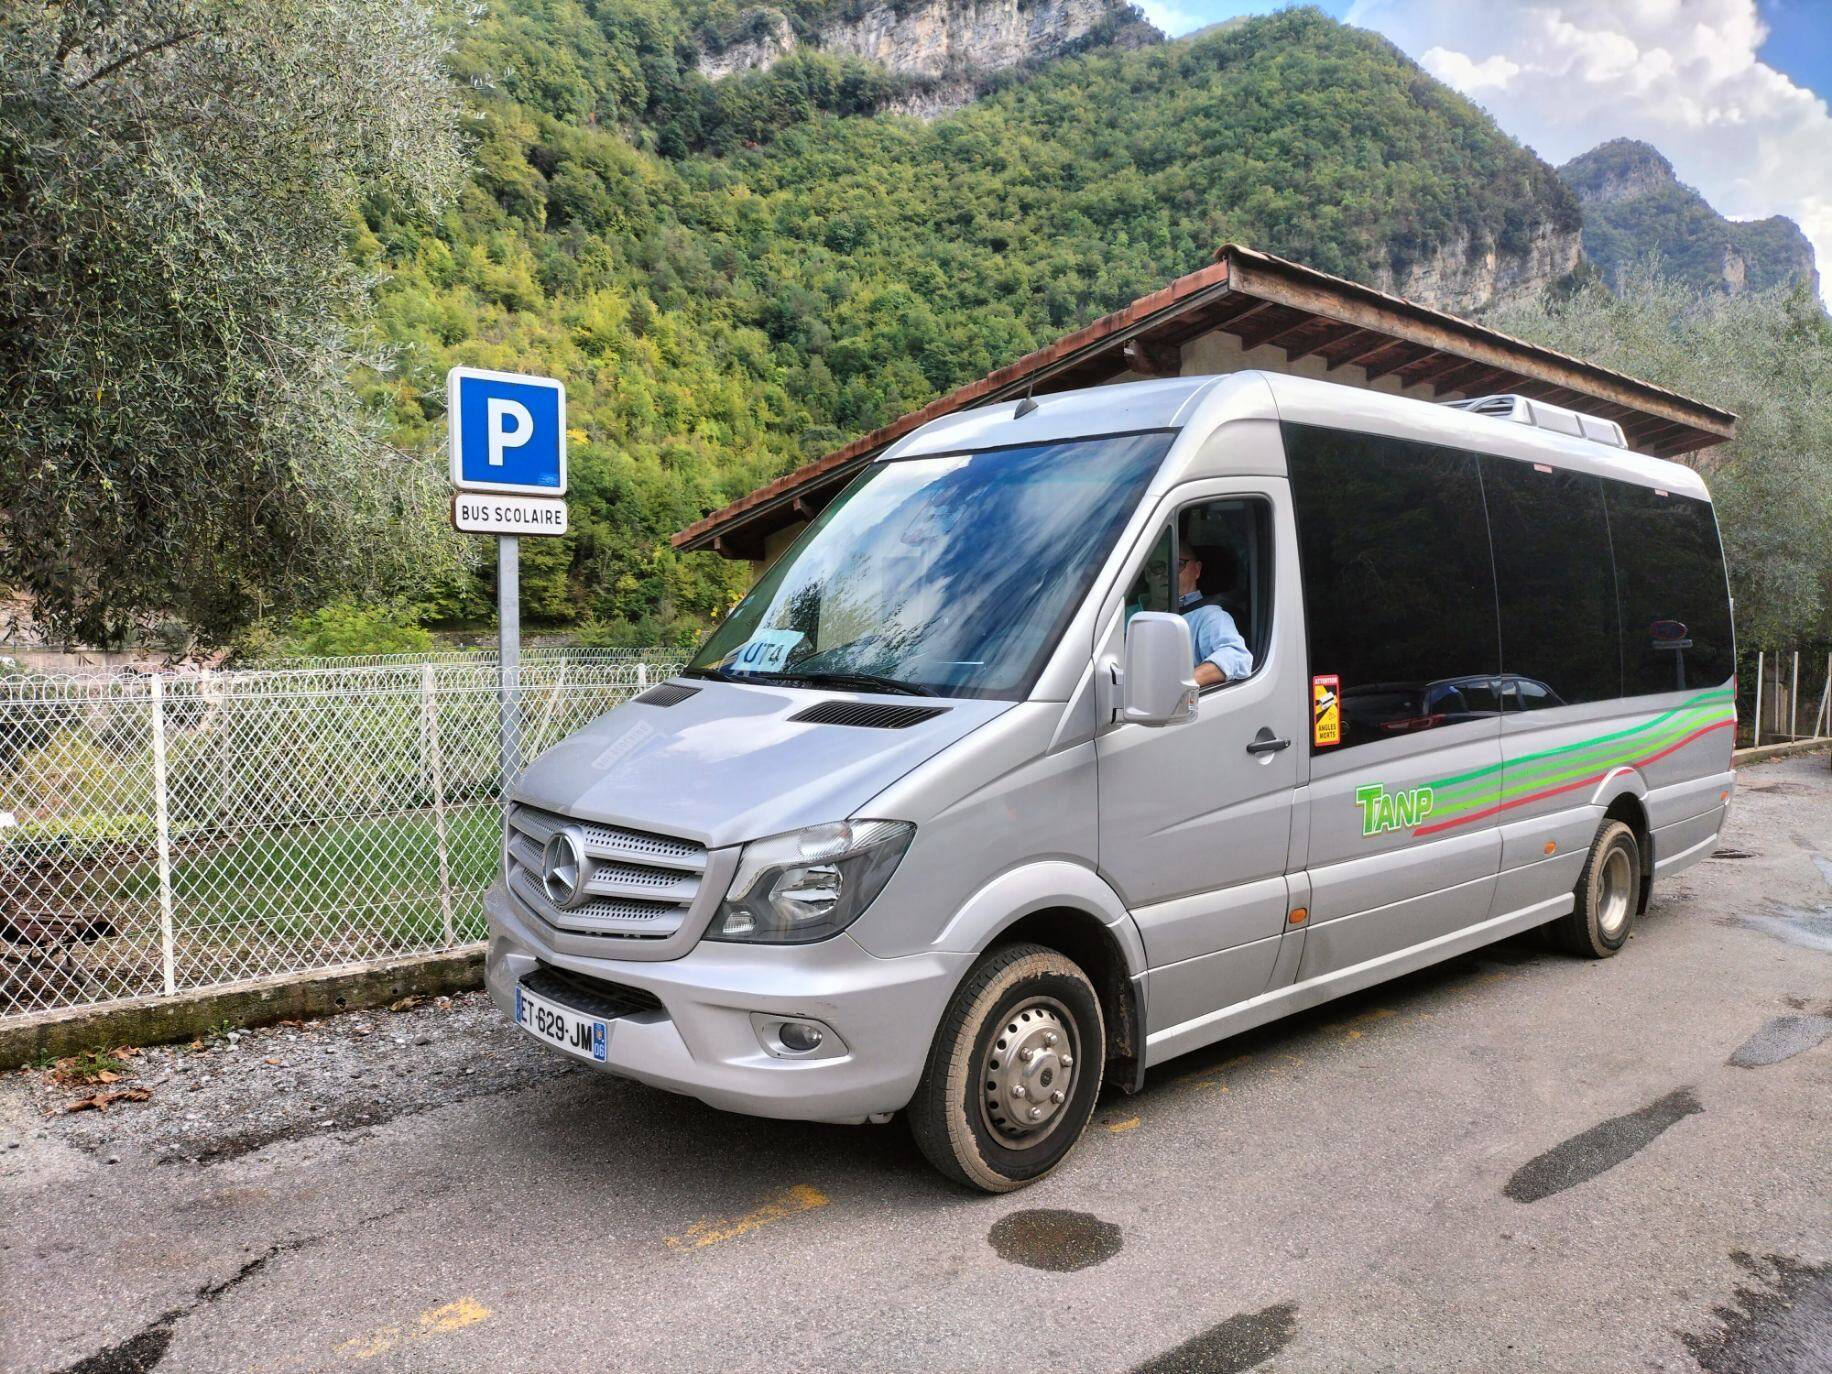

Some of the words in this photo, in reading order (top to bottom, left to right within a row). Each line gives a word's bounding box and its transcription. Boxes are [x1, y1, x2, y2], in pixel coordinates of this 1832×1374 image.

[487, 397, 534, 466] P
[462, 505, 489, 521] BUS
[495, 507, 562, 525] SCOLAIRE
[1318, 723, 1336, 732] ANGLES
[1319, 731, 1336, 739] MORTS
[1355, 783, 1433, 836] TANP
[594, 1042, 604, 1057] 06
